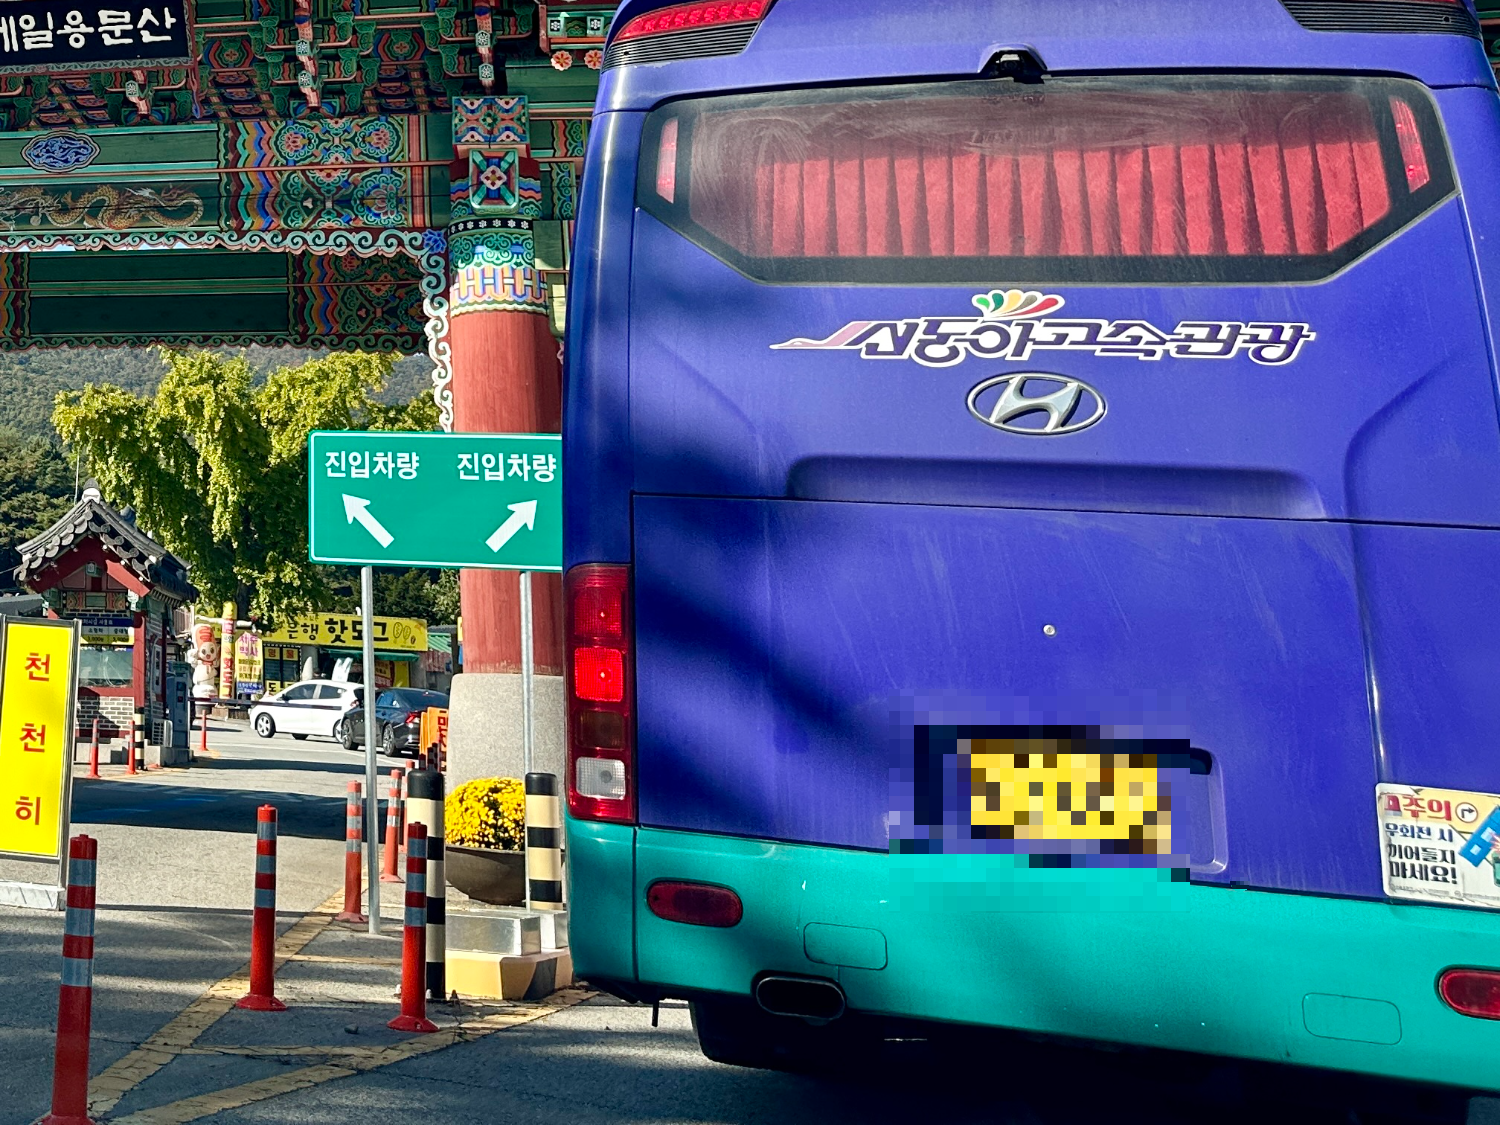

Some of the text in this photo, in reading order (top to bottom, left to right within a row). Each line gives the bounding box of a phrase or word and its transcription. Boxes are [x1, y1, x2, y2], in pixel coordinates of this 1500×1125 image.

[324, 450, 420, 480] 진입차량
[456, 452, 557, 483] 진입차량
[15, 652, 51, 825] 천천히
[1402, 795, 1453, 821] 주의
[1385, 822, 1454, 843] 우회전 시
[1389, 860, 1458, 885] 마세요!
